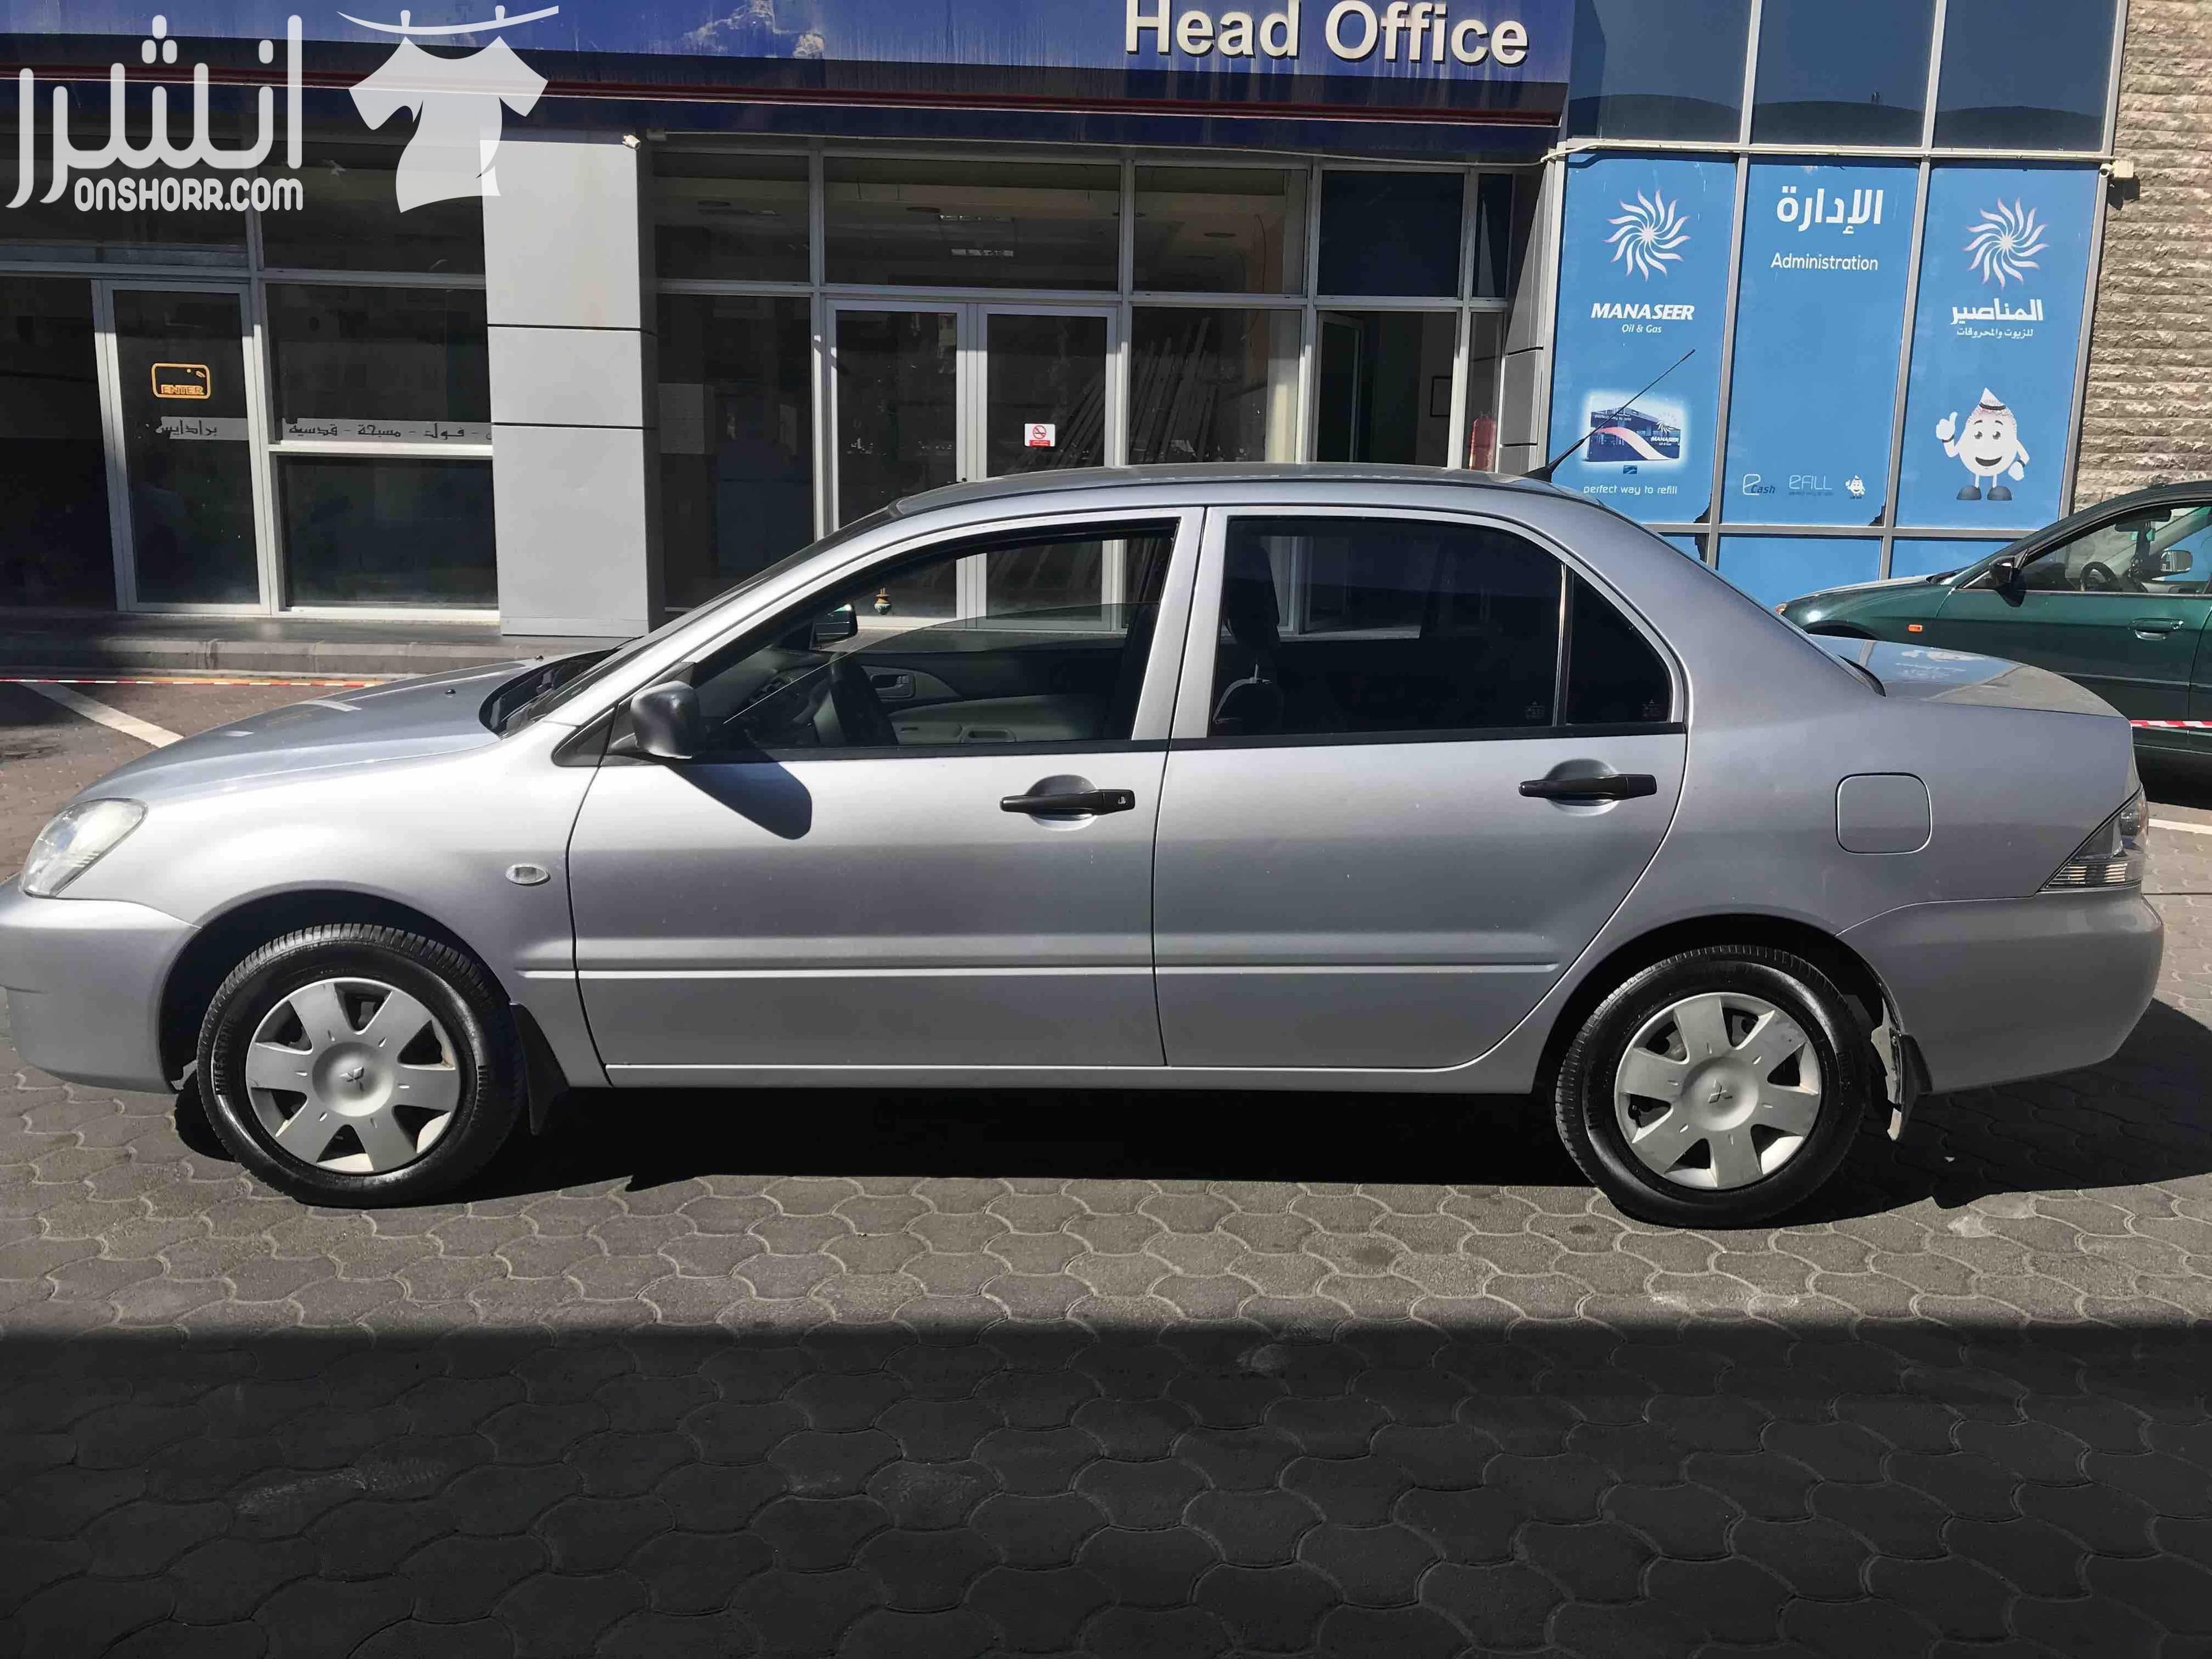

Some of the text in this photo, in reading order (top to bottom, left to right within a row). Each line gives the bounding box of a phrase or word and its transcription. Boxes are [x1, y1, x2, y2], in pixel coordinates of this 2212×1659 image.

[1126, 0, 1528, 65] Head Office
[1777, 185, 1884, 234] الإدارة
[1771, 252, 1878, 270] Administration
[1590, 303, 1695, 320] MANASEER
[1950, 298, 2043, 325] المناصير
[1622, 324, 1662, 333] Oil & Gas
[2004, 328, 2033, 339] للزيوت
[161, 384, 204, 395] ENTER
[1584, 484, 1617, 494] perfect
[1645, 486, 1653, 494] to
[1658, 486, 1677, 494] refill
